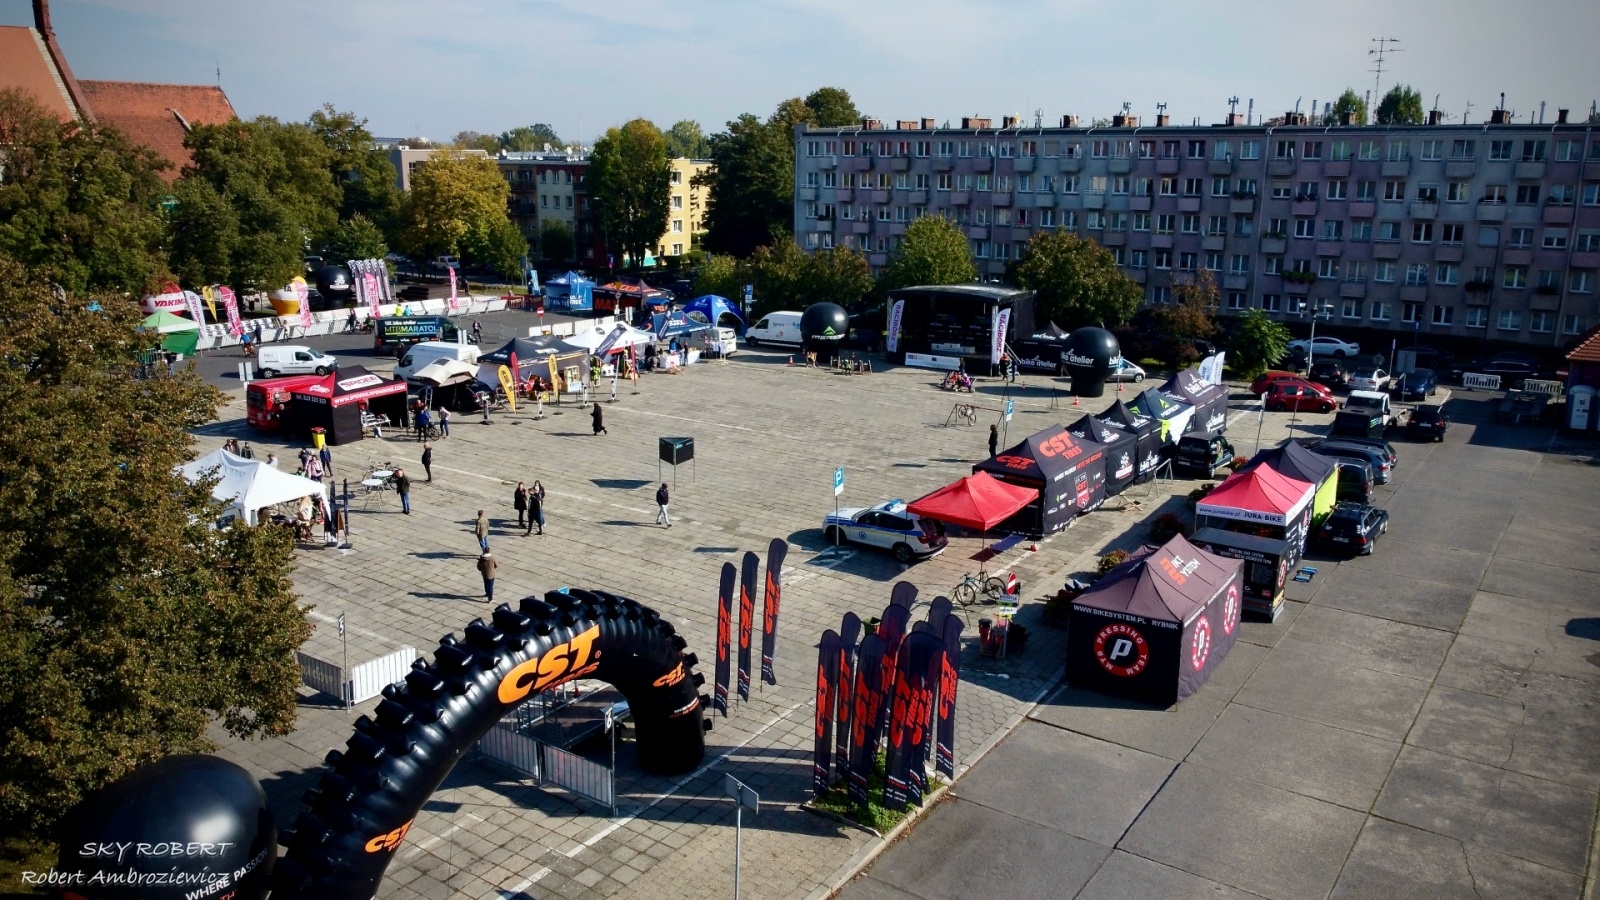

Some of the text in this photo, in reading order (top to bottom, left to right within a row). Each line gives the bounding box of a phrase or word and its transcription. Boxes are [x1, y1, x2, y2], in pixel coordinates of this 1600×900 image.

[1019, 357, 1057, 368] bike atelier
[1069, 355, 1094, 365] atelier
[1040, 430, 1071, 458] CST
[1062, 446, 1082, 460] TIRES
[996, 455, 1036, 466] CST
[836, 470, 842, 485] P
[1243, 511, 1262, 520] JURA
[1264, 514, 1282, 523] BIKE
[740, 584, 752, 649] CST
[766, 570, 775, 634] CST
[1073, 604, 1178, 630] WWW.BIKESYSTEM.PL RYBNIK
[718, 596, 727, 662] CST
[497, 624, 599, 704] CST
[1096, 625, 1143, 644] PRESSING
[1126, 654, 1147, 675] TEAM
[1110, 639, 1133, 660] P
[540, 661, 599, 693] TIRES
[653, 661, 683, 687] CST
[853, 671, 869, 748] CST
[890, 669, 910, 749] CST
[365, 818, 414, 853] CST
[185, 847, 269, 900] WHERE PASSION
